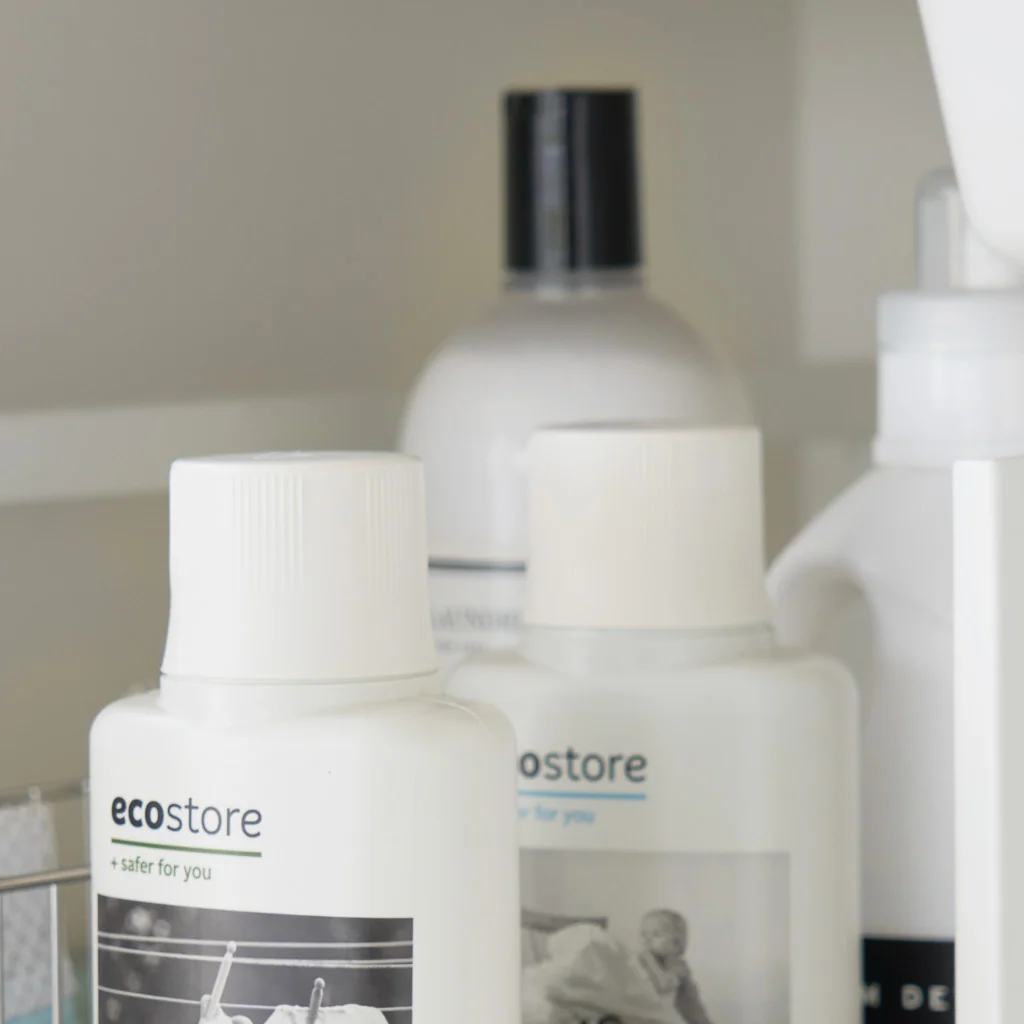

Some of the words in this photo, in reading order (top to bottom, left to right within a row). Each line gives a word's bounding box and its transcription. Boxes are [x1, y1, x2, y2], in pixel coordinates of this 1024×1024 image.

[518, 747, 647, 784] ostore
[111, 797, 263, 838] ecostore
[121, 857, 154, 875] safer
[158, 858, 179, 877] for
[183, 863, 212, 883] you
